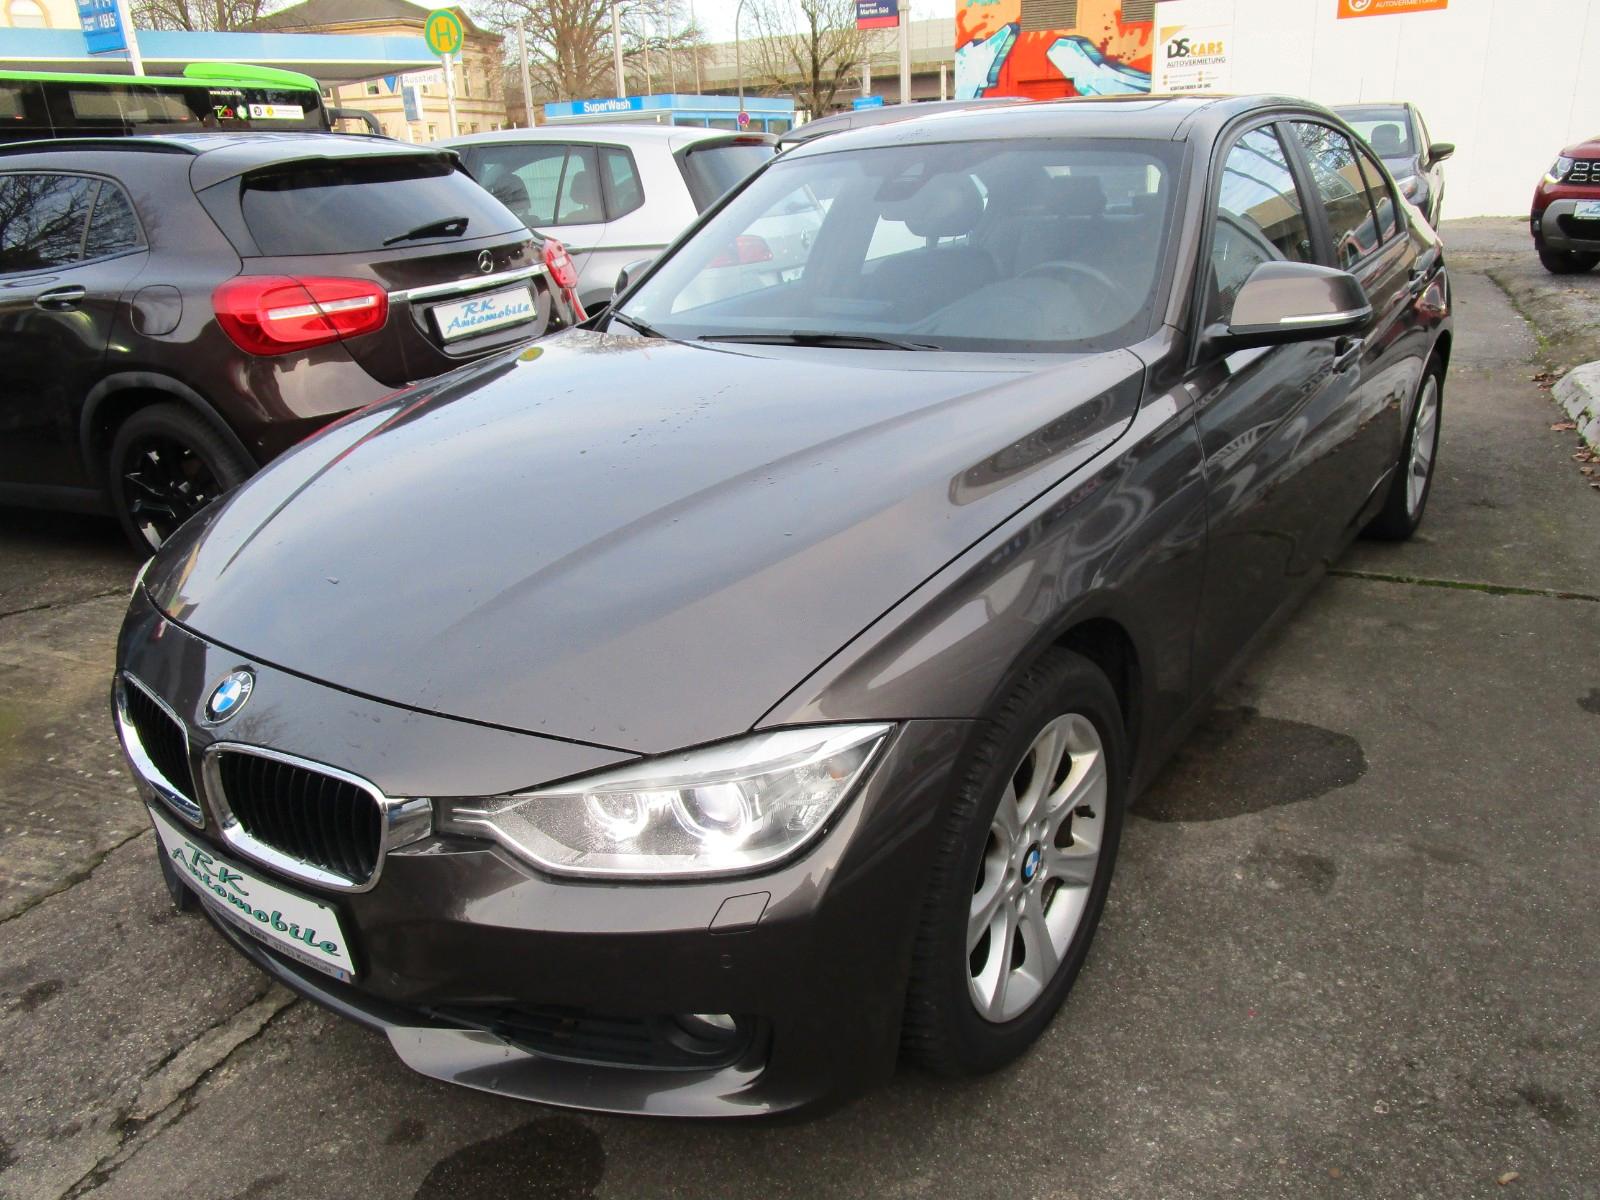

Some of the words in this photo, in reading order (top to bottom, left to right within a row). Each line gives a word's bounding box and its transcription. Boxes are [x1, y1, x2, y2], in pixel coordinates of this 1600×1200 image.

[583, 99, 631, 113] SuperWash
[446, 303, 530, 335] Automobile
[171, 847, 341, 957] Automobile
